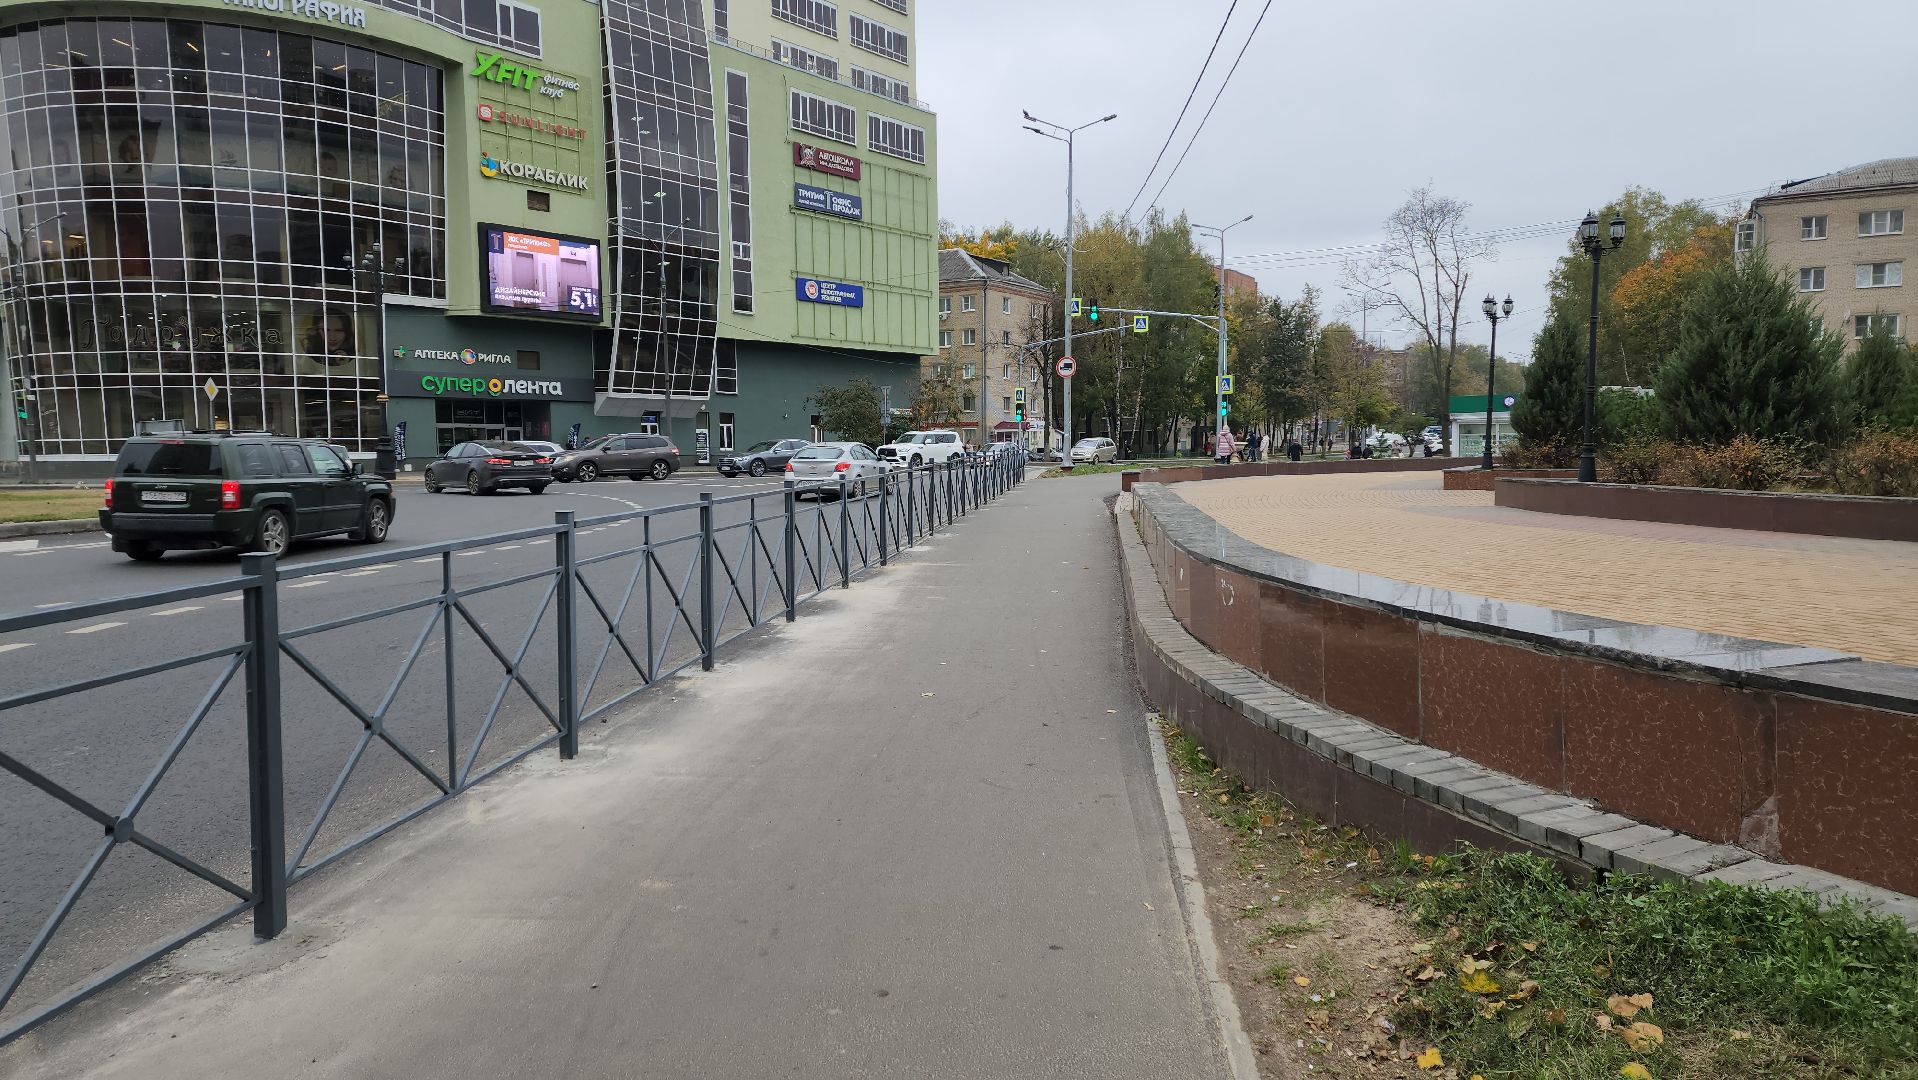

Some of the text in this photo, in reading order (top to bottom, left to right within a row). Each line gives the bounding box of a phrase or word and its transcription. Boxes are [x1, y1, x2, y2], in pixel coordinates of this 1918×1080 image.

[470, 49, 539, 90] XFIT
[543, 74, 580, 90] фитнес
[540, 86, 564, 98] клуб
[498, 111, 587, 140] SUNLIGHT
[500, 160, 588, 189] КОРАБЛИК
[798, 189, 825, 200] ТРИУМФ
[832, 197, 851, 207] ОФИС
[832, 204, 860, 215] ПРОДАЖ
[414, 349, 512, 364] АПТЕКА РИГЛА
[421, 375, 563, 396] супер лента
